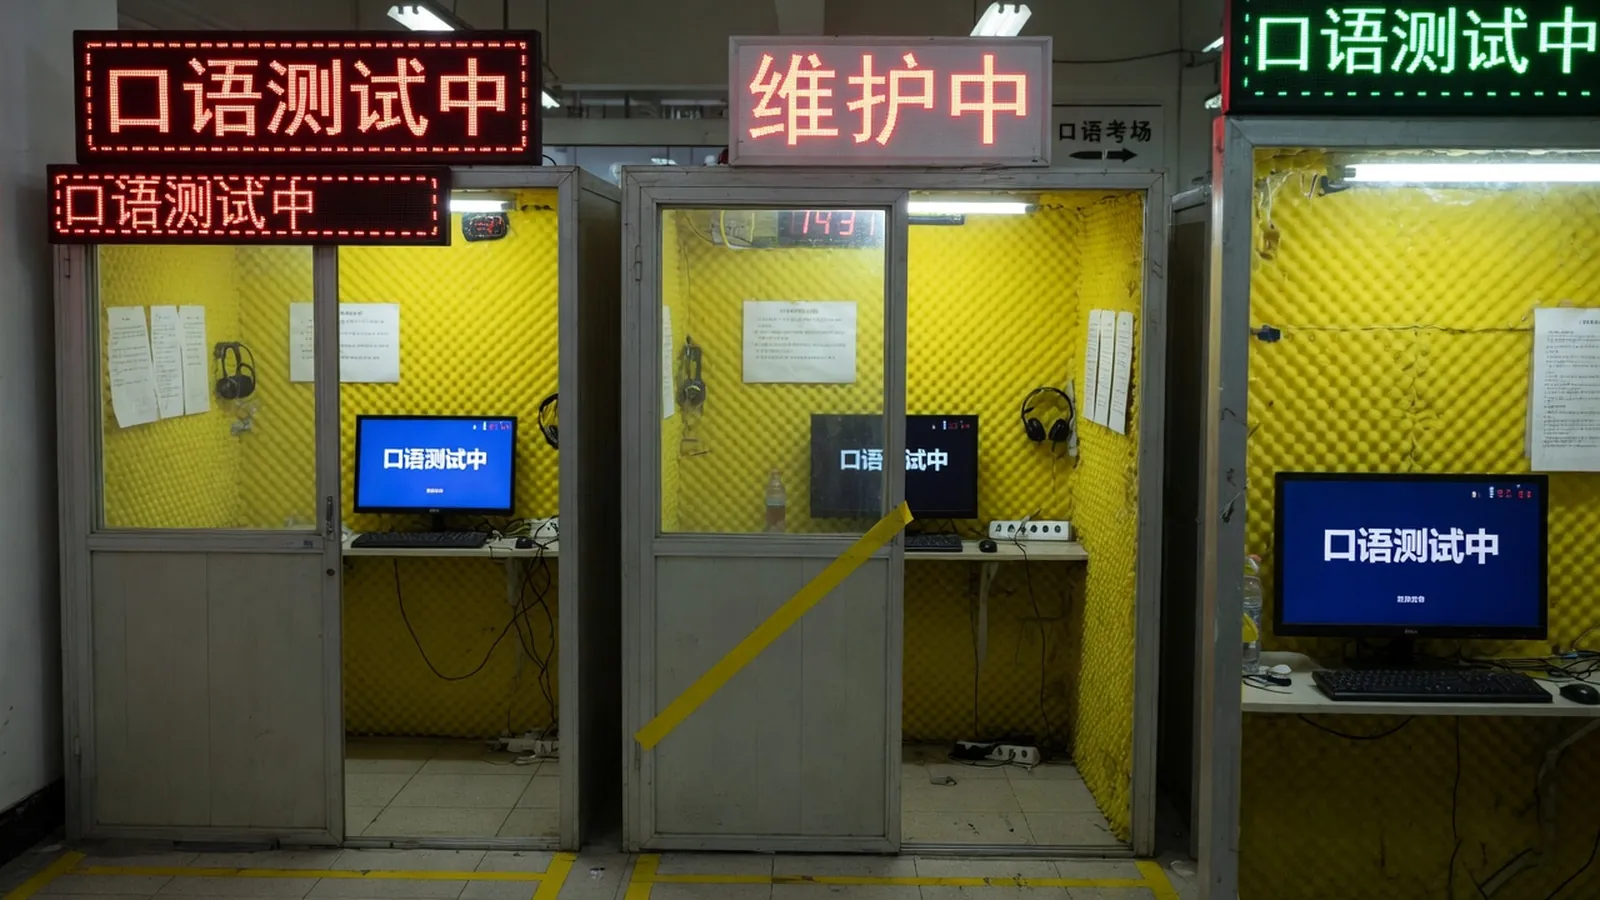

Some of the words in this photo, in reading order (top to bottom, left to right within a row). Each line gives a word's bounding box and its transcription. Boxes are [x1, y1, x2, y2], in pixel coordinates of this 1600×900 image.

[1257, 6, 1598, 75] 口语测试中
[108, 57, 507, 138] 口语测试中
[748, 52, 1028, 146] 维护中
[1059, 120, 1152, 143] 口语考场
[65, 177, 314, 231] 口语测试中
[383, 448, 488, 471] 口语测试中
[840, 448, 949, 472] 口语试中
[1323, 527, 1500, 565] 口语测试中
